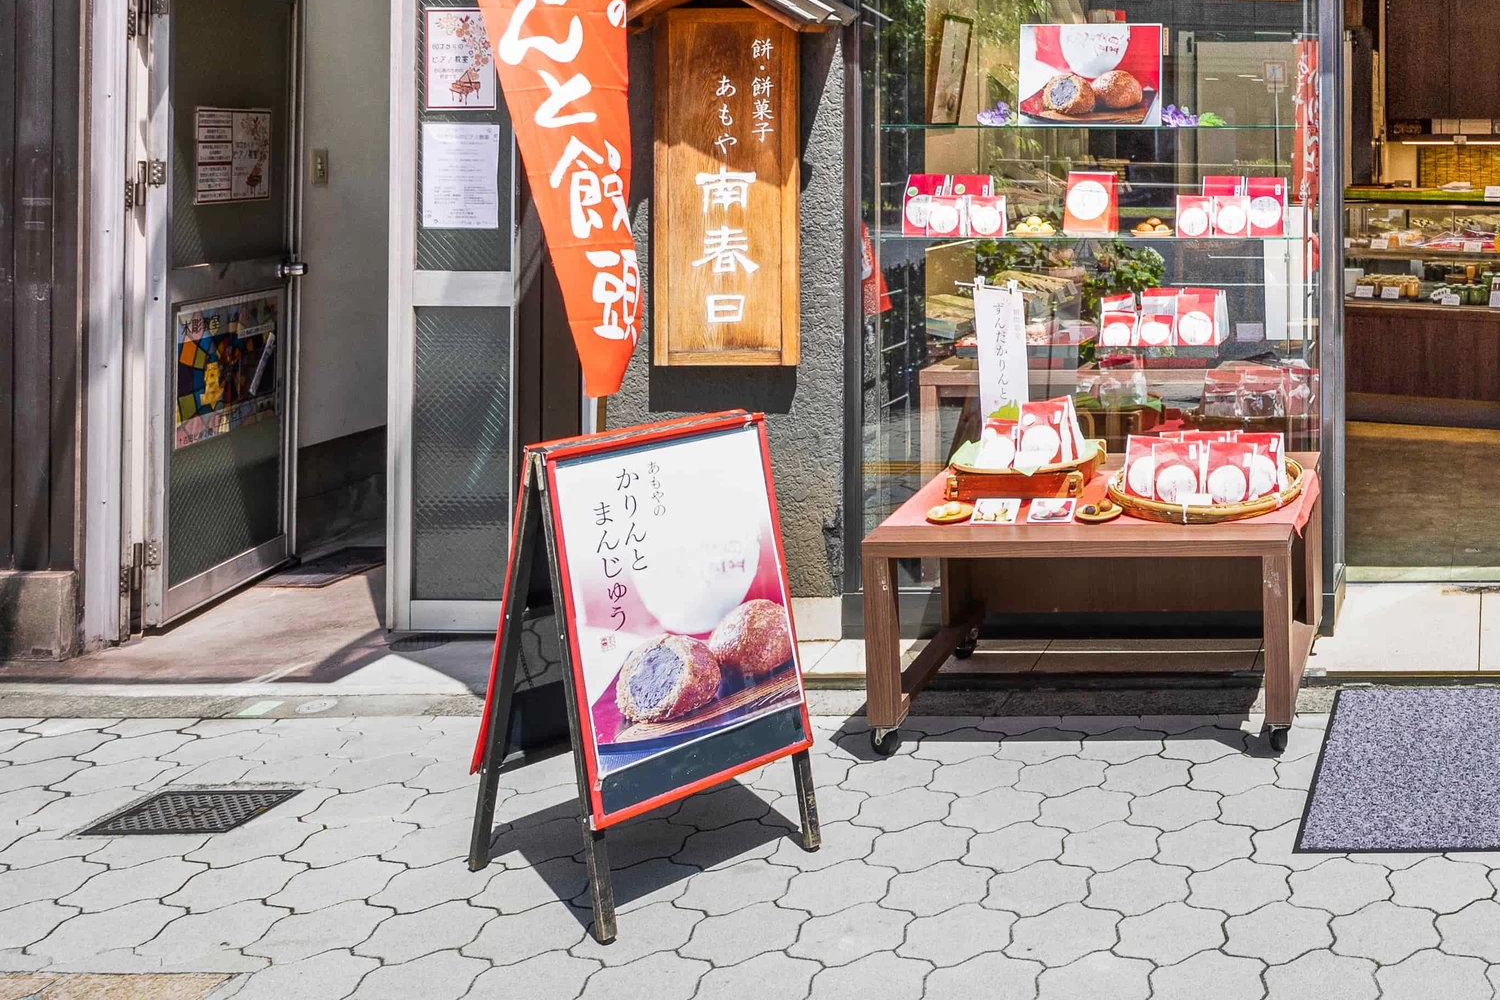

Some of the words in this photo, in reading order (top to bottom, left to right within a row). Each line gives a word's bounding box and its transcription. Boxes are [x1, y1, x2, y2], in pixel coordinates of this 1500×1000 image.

[714, 75, 738, 154] あもや
[750, 38, 775, 144] 餅・餅菓子
[691, 171, 760, 327] 南春日
[993, 302, 1009, 400] ずんだかりんと
[616, 468, 648, 572] かりんと
[647, 460, 666, 518] あもやの
[593, 502, 627, 632] まんじゅう
